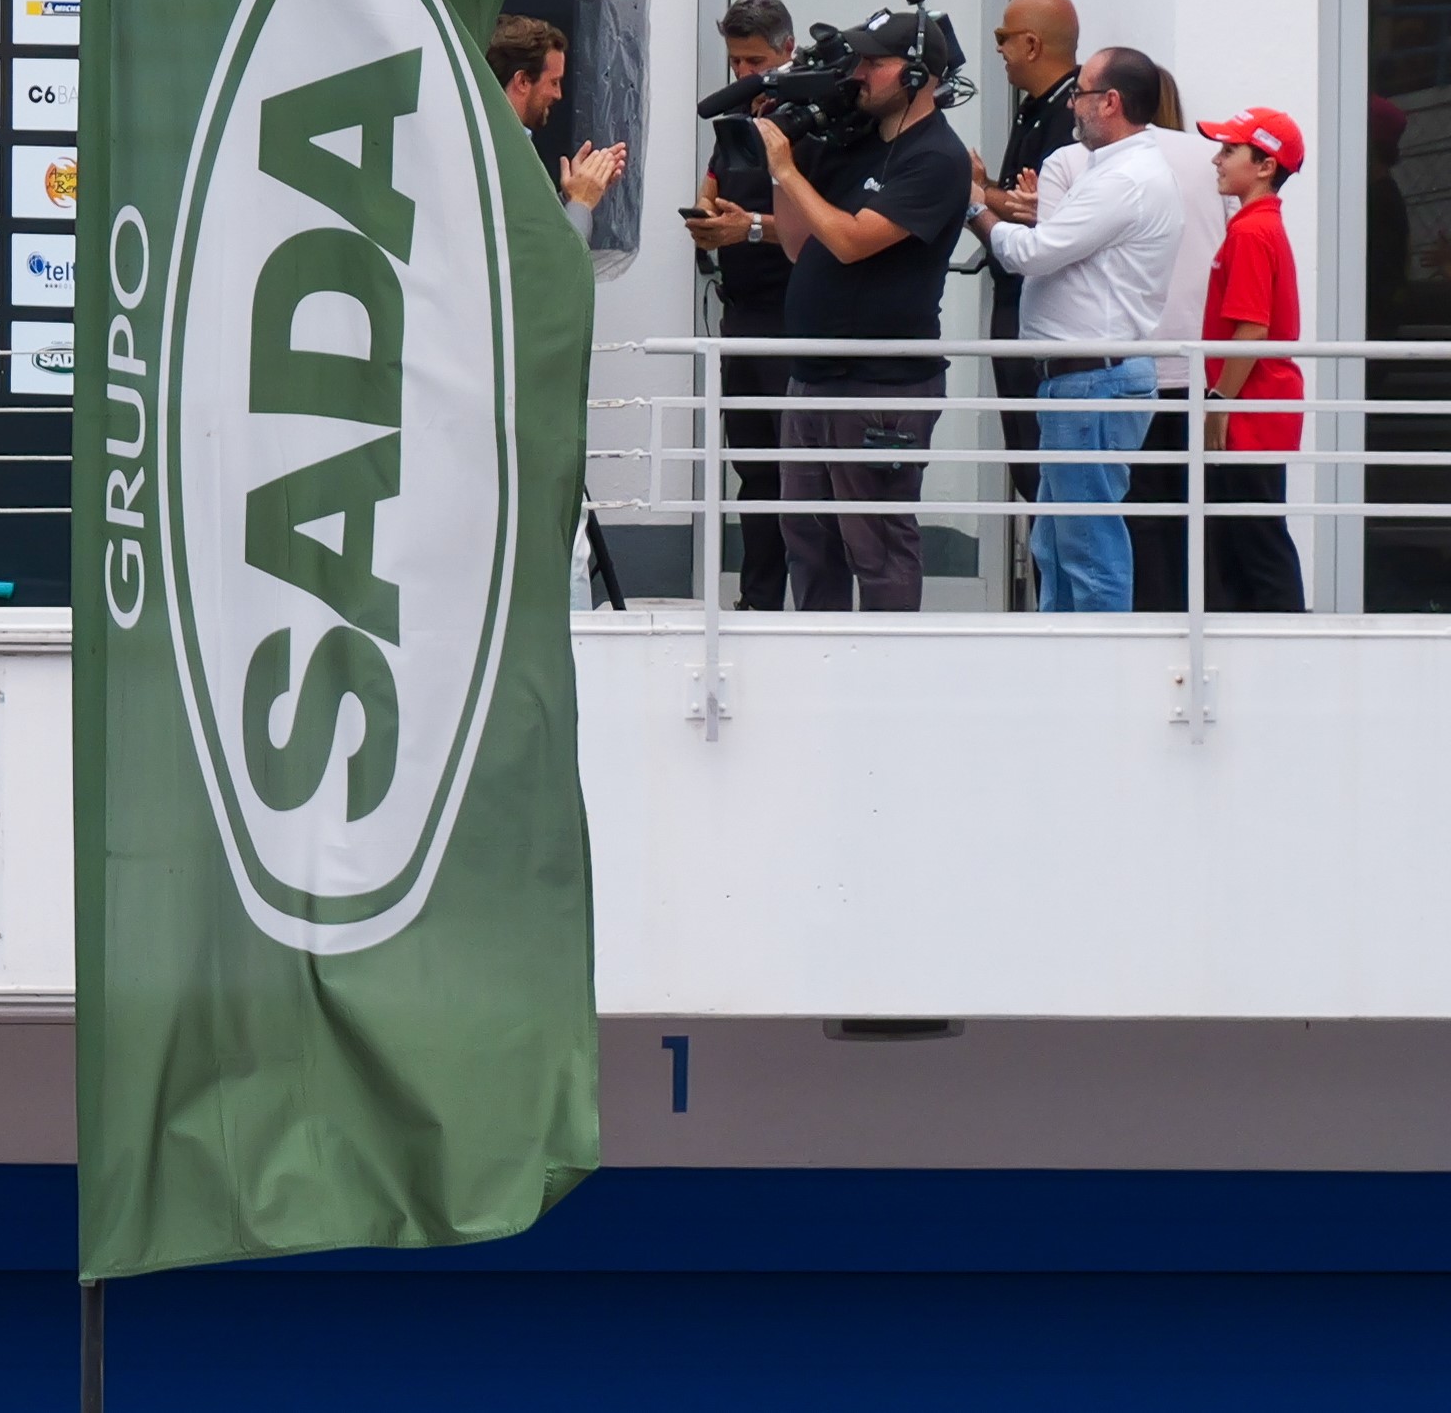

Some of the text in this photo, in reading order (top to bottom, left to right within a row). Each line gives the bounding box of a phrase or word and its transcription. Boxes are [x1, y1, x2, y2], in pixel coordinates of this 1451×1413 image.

[104, 204, 150, 630] GRUPO
[241, 46, 424, 825] SADA
[662, 1036, 689, 1112] 1
